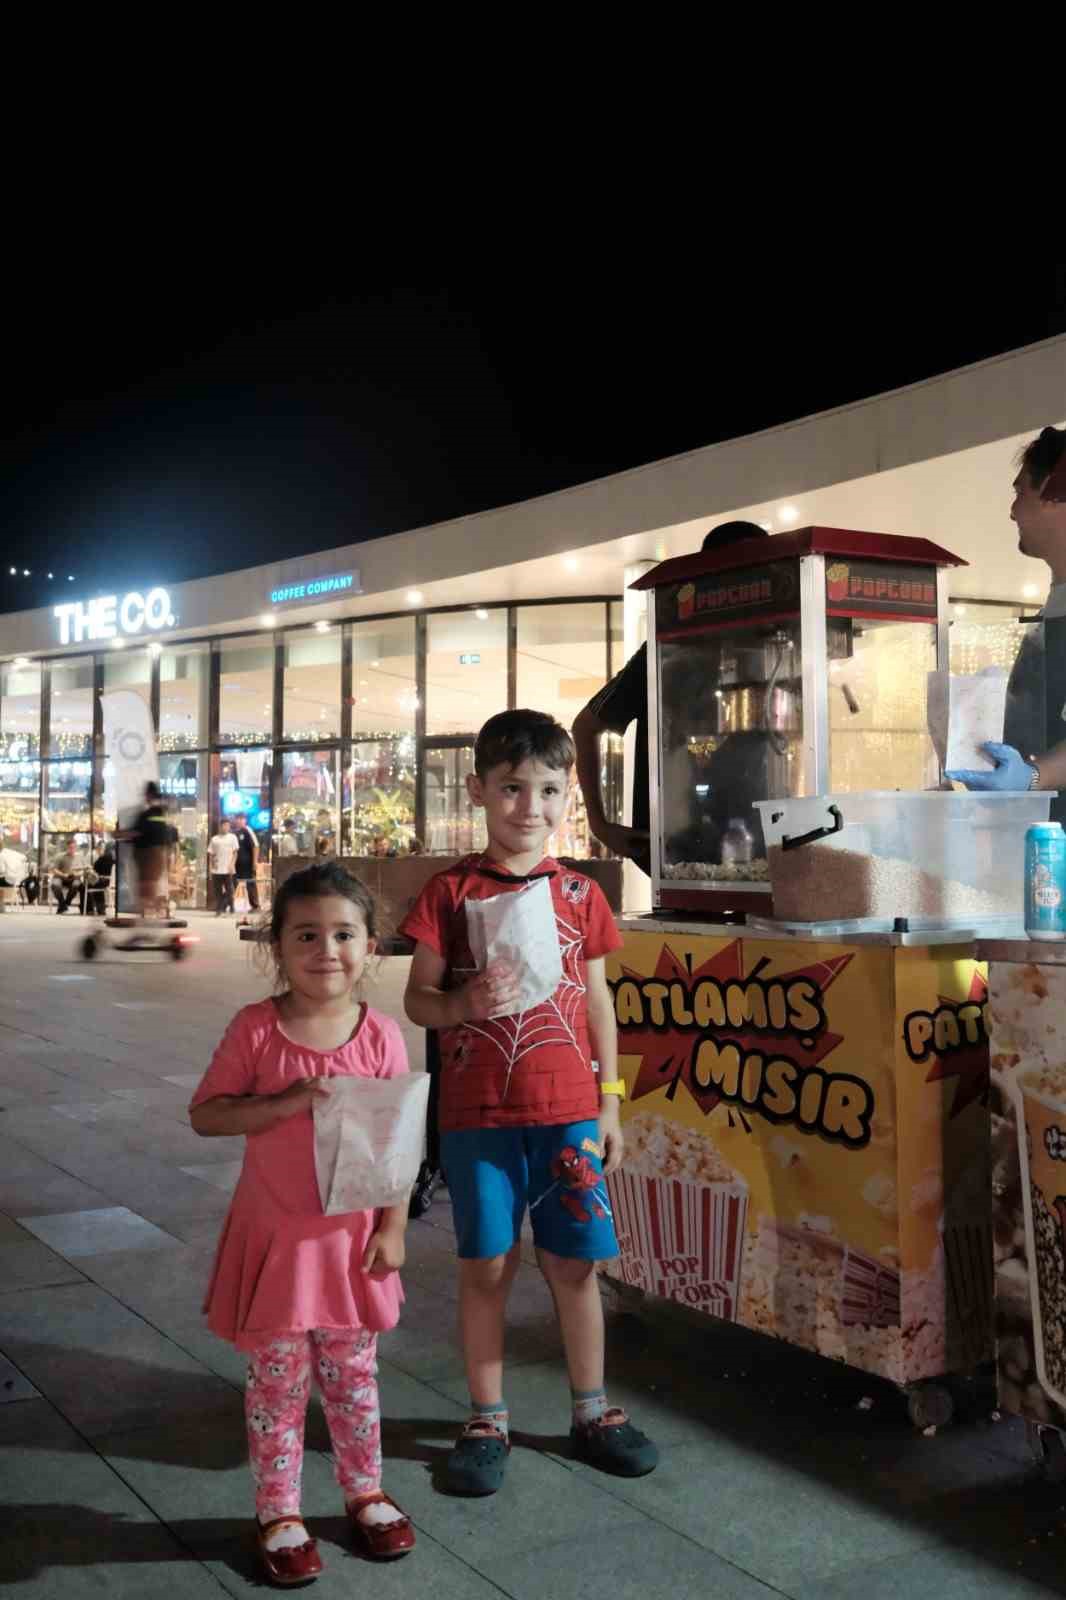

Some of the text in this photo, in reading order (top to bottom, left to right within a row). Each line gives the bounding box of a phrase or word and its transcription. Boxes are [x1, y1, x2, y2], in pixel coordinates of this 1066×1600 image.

[271, 575, 353, 603] COFFEE COMPANY
[848, 577, 936, 602] POPCORN
[54, 596, 117, 644] THE
[608, 977, 826, 1047] ATLAMIŞ
[691, 1035, 874, 1147] MISIR
[660, 1257, 699, 1278] POP
[671, 1281, 729, 1304] CORN
